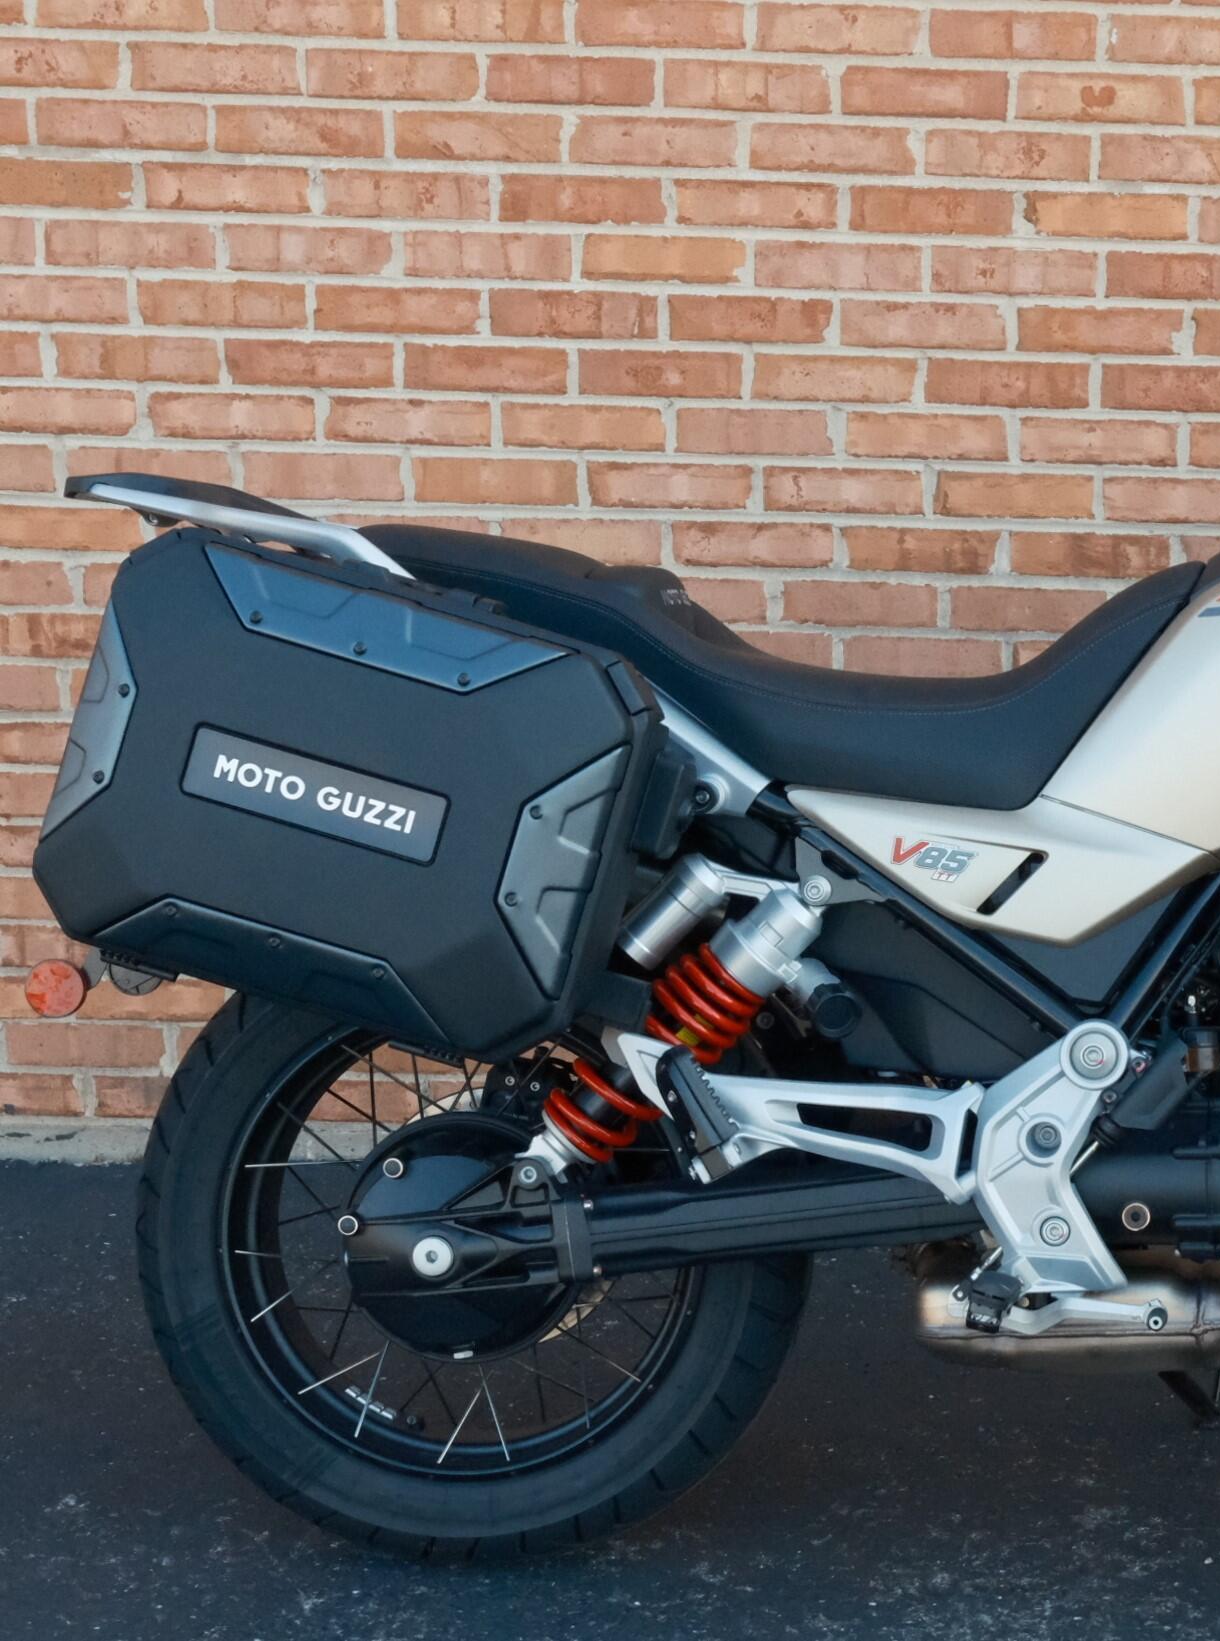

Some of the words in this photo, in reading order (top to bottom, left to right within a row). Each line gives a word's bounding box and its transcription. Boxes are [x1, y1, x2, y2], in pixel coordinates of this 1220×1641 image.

[213, 754, 306, 801] MOTO
[316, 785, 417, 834] GUZZI
[892, 837, 976, 874] V85
